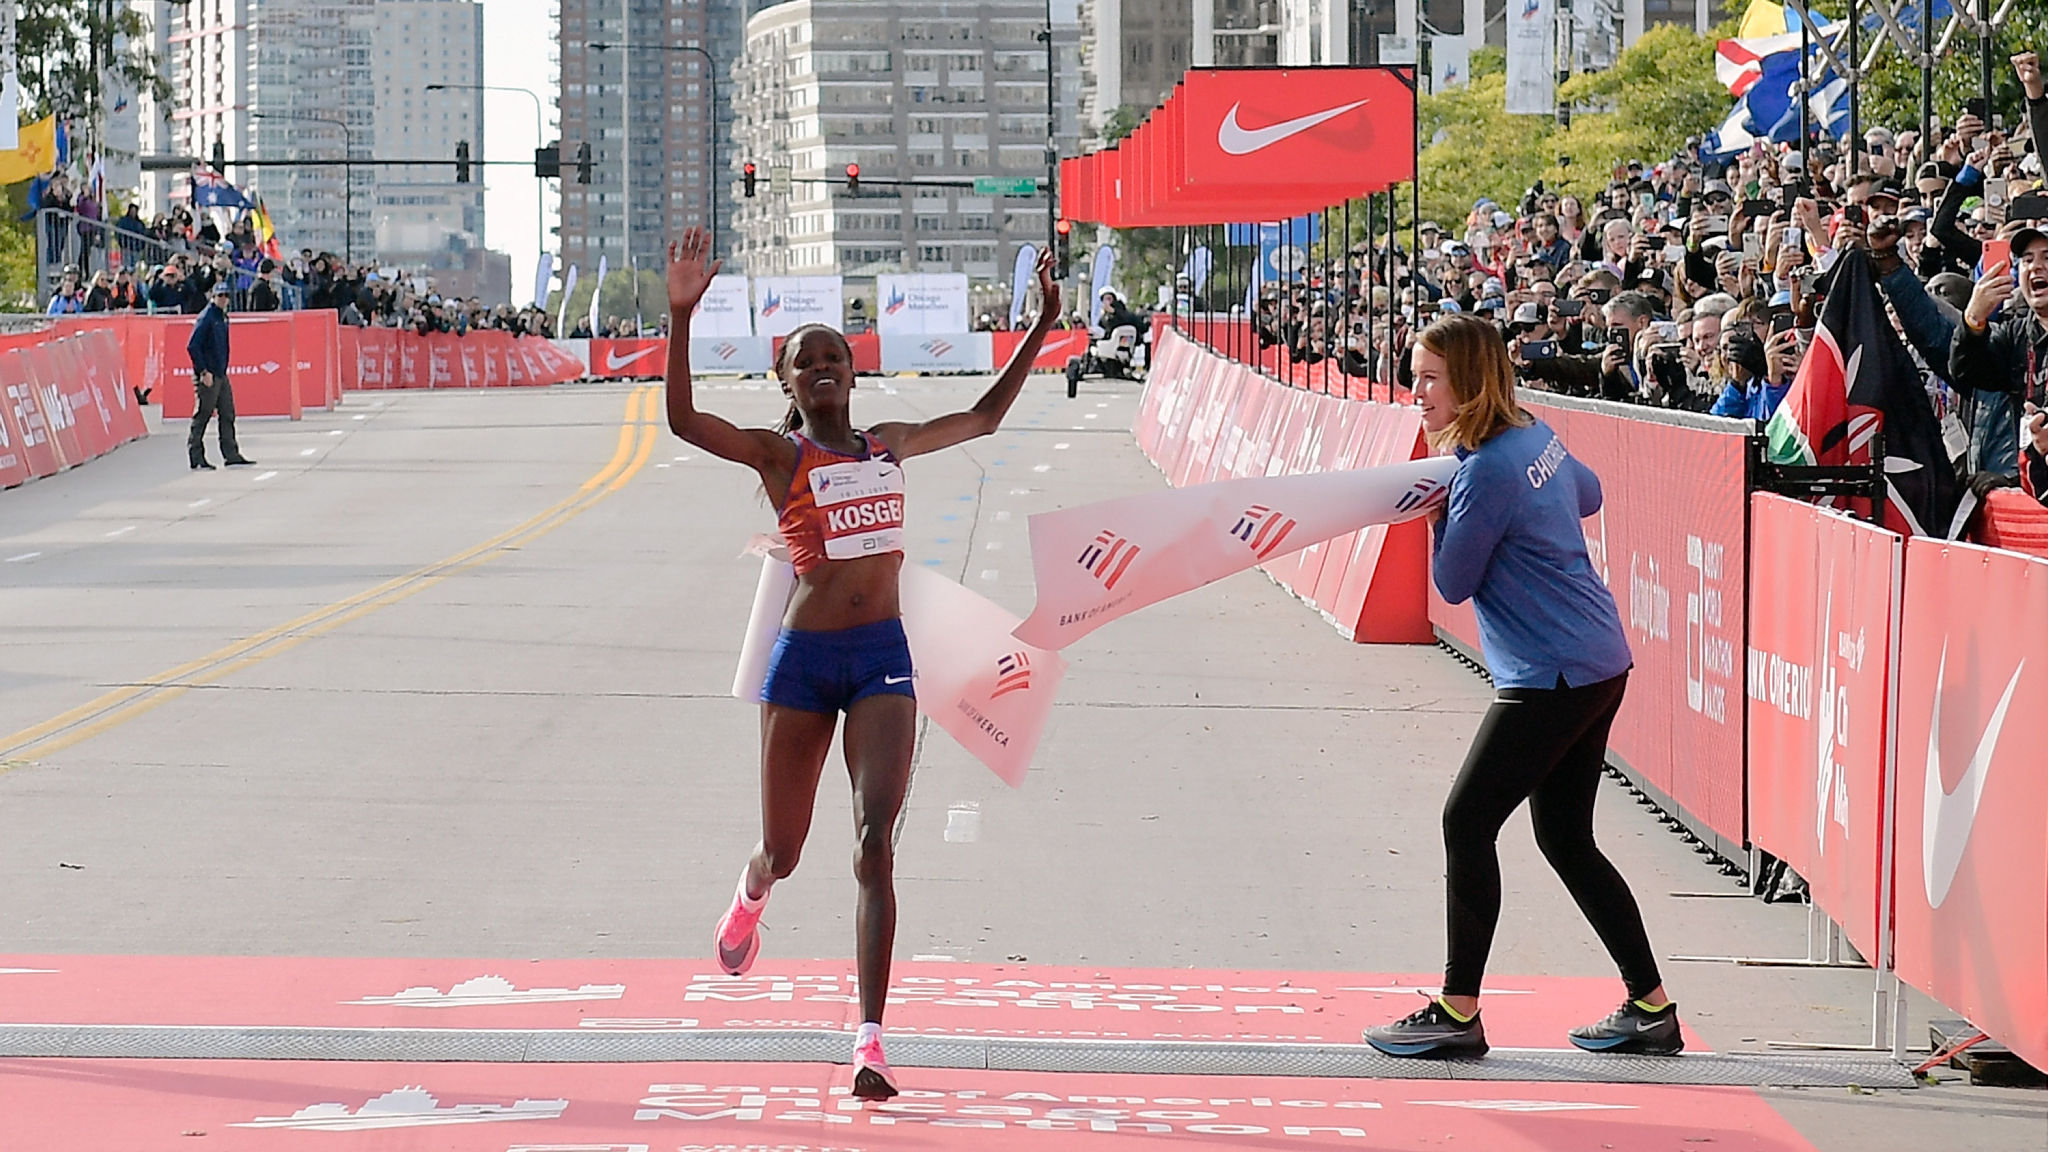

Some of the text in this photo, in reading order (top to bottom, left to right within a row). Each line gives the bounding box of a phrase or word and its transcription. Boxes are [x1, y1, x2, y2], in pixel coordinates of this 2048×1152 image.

[173, 366, 259, 376] BAN ERICA
[685, 981, 1180, 1001] Chcago
[991, 979, 1319, 994] America
[1001, 1091, 1384, 1109] America
[633, 1107, 1367, 1138] Marathon
